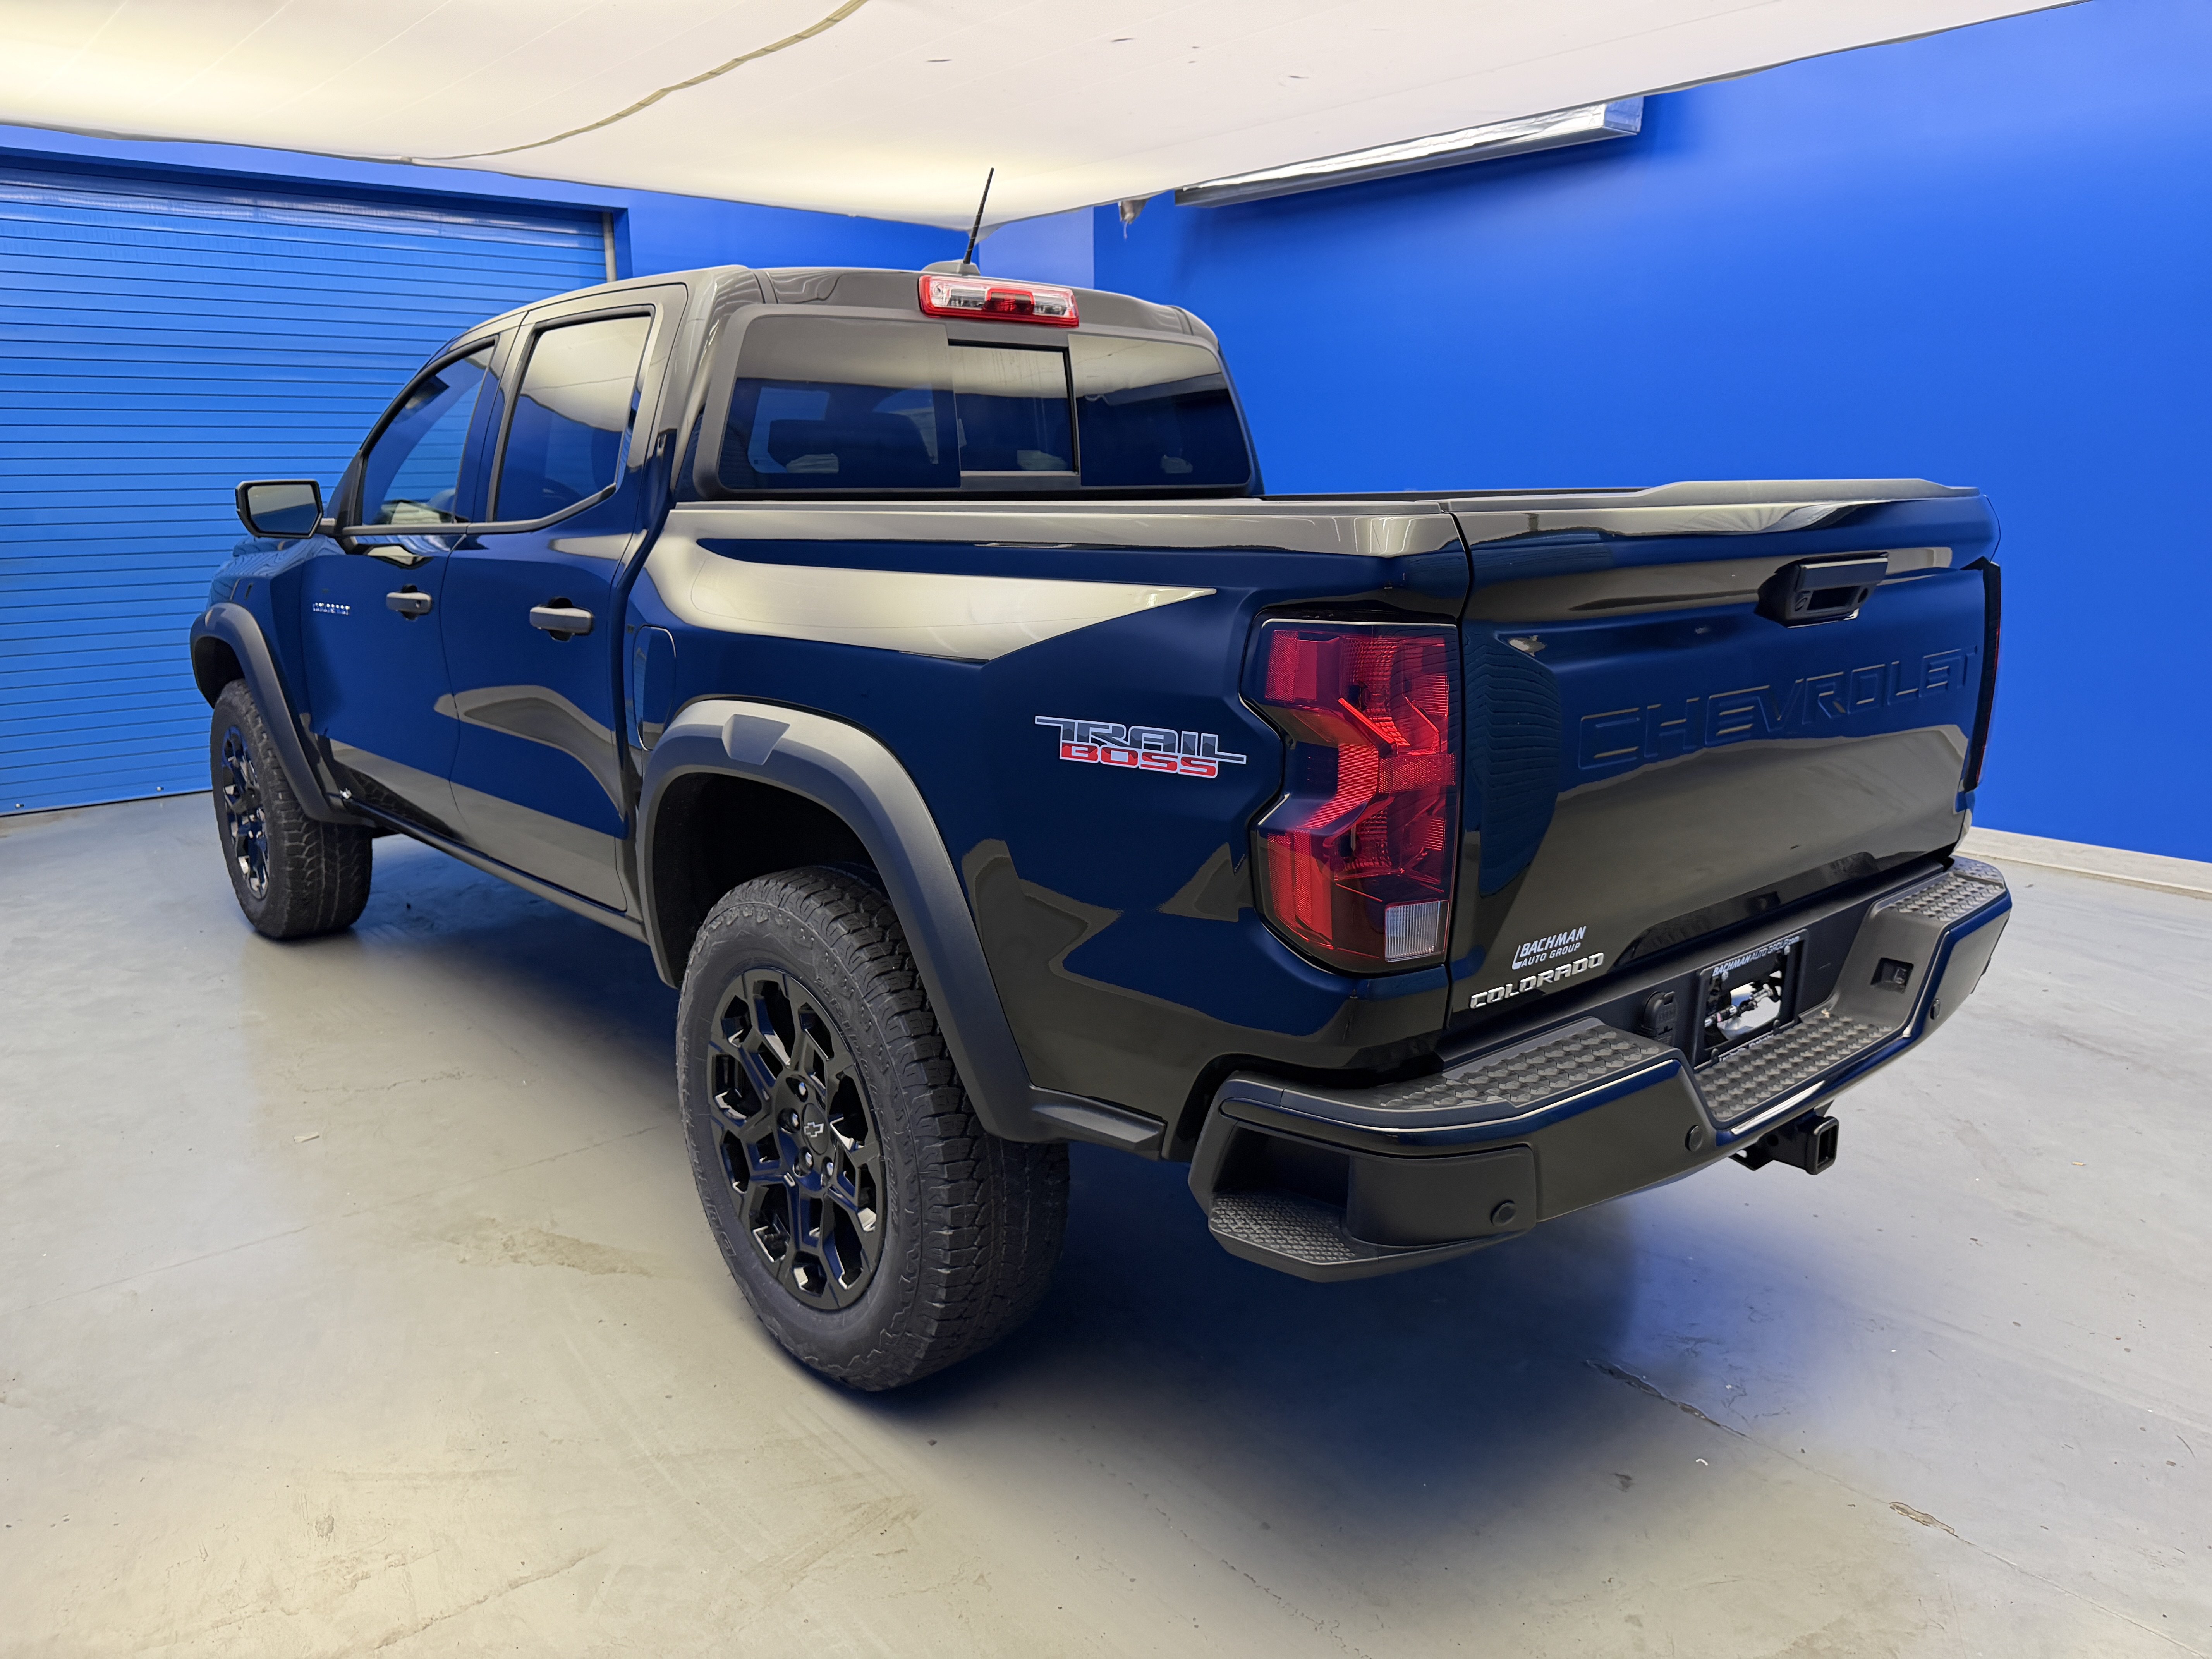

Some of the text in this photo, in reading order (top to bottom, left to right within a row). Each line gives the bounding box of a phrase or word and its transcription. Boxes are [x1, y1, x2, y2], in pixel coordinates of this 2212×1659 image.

[1578, 644, 1977, 770] CHEVROLET
[1035, 716, 1247, 764] TRAIL
[1059, 742, 1218, 778] BOSS
[1517, 926, 1587, 959] BACHMAN
[1521, 942, 1581, 968] AUTO GROUP
[1470, 952, 1604, 1009] COLORADO
